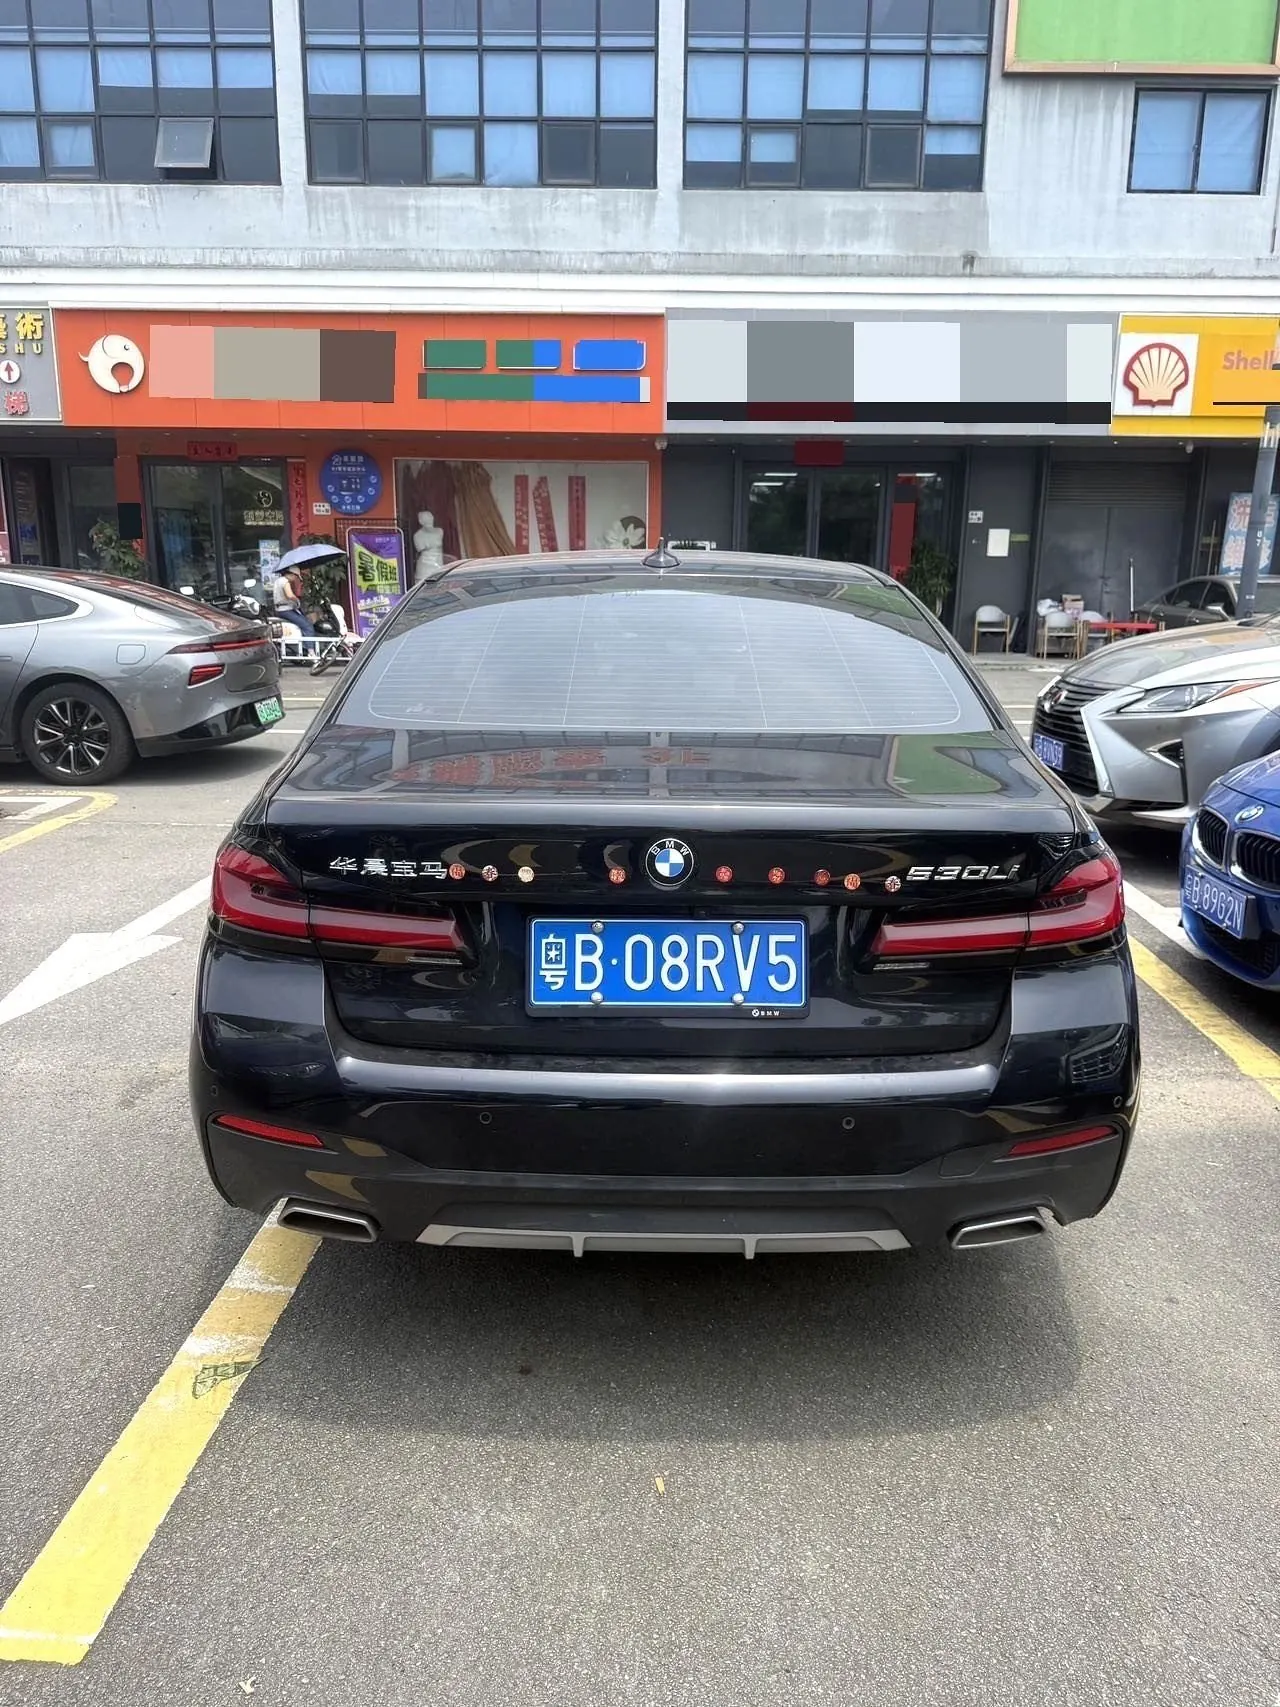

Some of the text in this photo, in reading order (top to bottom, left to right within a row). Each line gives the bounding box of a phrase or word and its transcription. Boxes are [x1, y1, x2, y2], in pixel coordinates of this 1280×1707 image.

[1222, 350, 1275, 370] Shell
[358, 551, 397, 582] 暑假班
[651, 840, 690, 856] BMW
[330, 856, 448, 880] 华晨宝马
